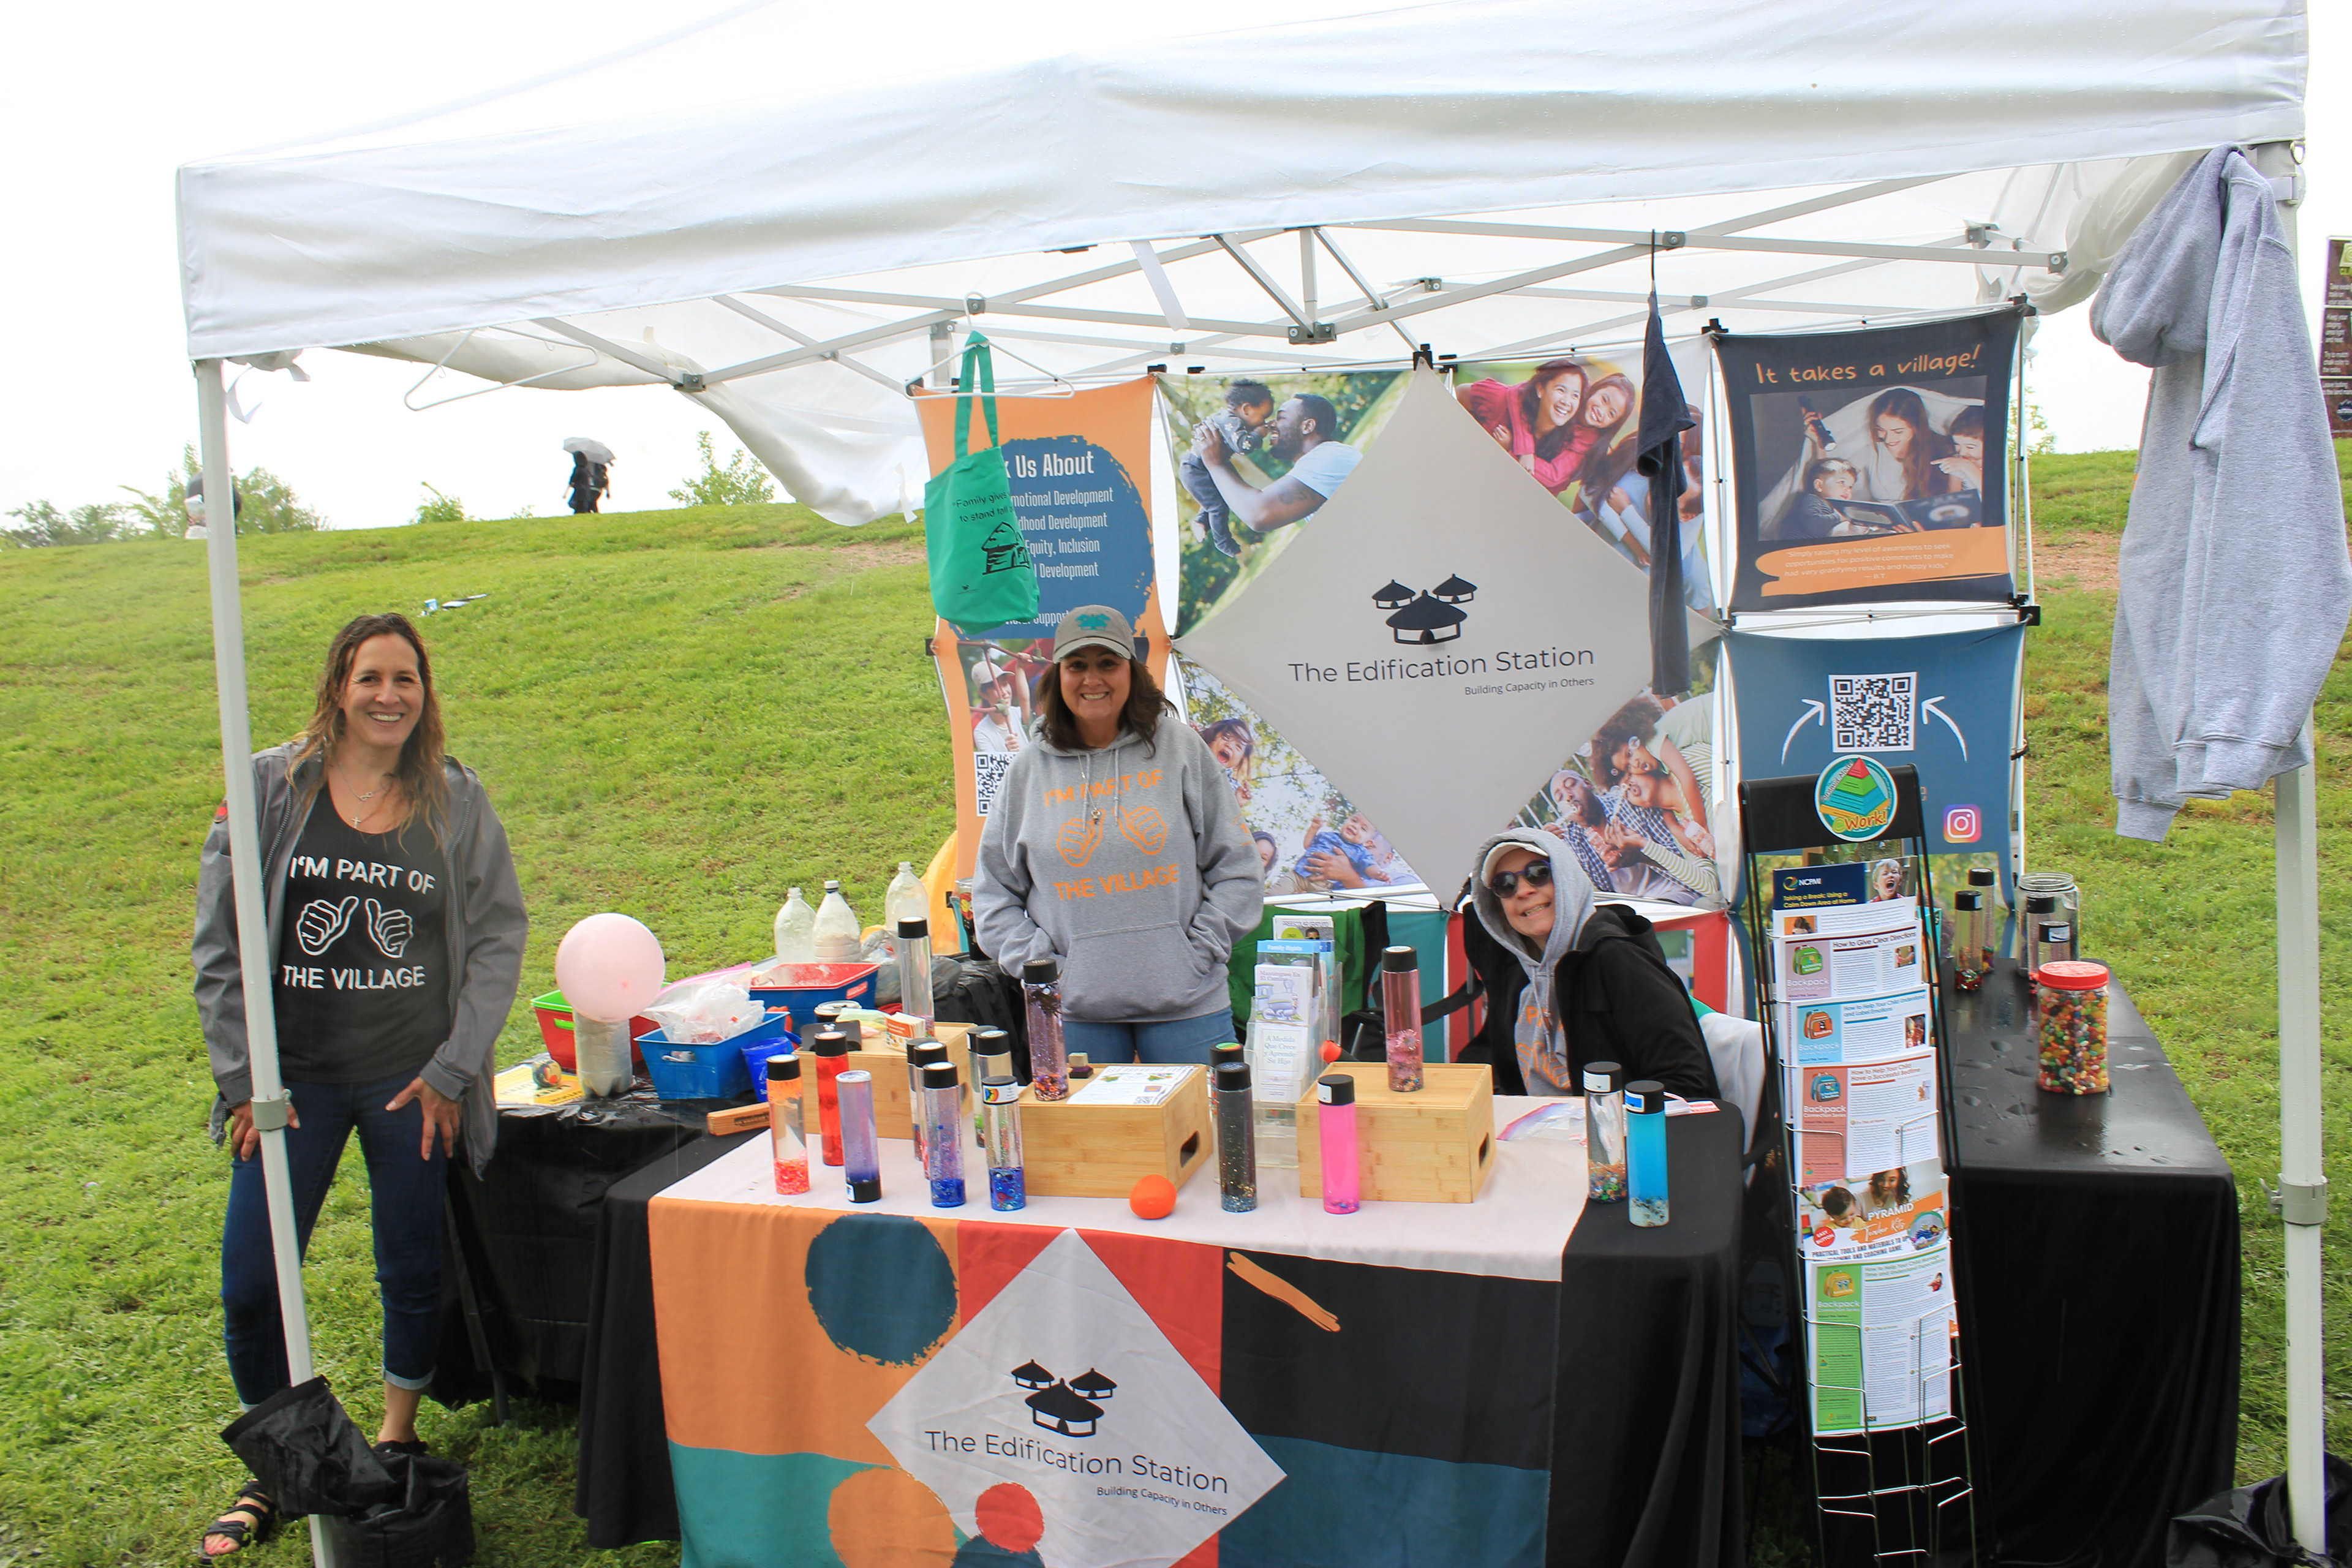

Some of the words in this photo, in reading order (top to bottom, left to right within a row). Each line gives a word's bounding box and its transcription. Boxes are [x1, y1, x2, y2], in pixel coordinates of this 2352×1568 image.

[1755, 363, 1778, 384] It
[1789, 364, 1857, 382] takes
[1869, 364, 1885, 377] a
[1898, 344, 1982, 375] village!
[1015, 454, 1037, 478] Us
[1042, 451, 1094, 477] About
[989, 492, 1007, 503] gives
[1054, 487, 1114, 507] Development
[971, 508, 995, 522] stand
[997, 506, 1009, 515] tall
[1049, 512, 1107, 532] Development
[1025, 538, 1057, 558] Equity,
[1058, 537, 1100, 554] Inclusion
[1814, 548, 1839, 557] raising
[1039, 562, 1099, 581] Development
[1785, 558, 1836, 568] opportunities
[1850, 555, 1880, 564] positive
[1819, 565, 1857, 575] gratifying
[1902, 562, 1927, 571] happy
[1288, 663, 1338, 682] The
[1347, 654, 1487, 681] Edification
[1496, 646, 1594, 672] Station
[1464, 684, 1503, 696] Building
[1506, 680, 1547, 693] Capacity
[1548, 679, 1558, 688] in
[1560, 676, 1594, 688] Others
[1044, 786, 1074, 807] I'M
[1080, 775, 1133, 799] PART
[1137, 769, 1164, 789] OF
[1819, 777, 1840, 802] Pyramid
[1839, 760, 1854, 778] Model
[290, 856, 330, 879] I'M
[336, 858, 404, 888] PART
[407, 870, 436, 895] OF
[1052, 878, 1096, 901] THE
[1098, 864, 1179, 895] VILLAGE
[1890, 932, 1917, 941] Directions
[282, 964, 325, 989] THE
[331, 965, 426, 990] VILLAGE
[1787, 978, 1830, 987] Backpack
[1803, 1105, 1847, 1114] Backpack
[1868, 1202, 1915, 1221] PYRAMID
[1815, 1233, 1836, 1244] BUTTON
[1816, 1229, 1829, 1238] EASY
[1811, 1249, 1839, 1258] PRACTICAL
[1840, 1246, 1856, 1255] TOOLS
[1868, 1238, 1895, 1251] MATERIALS
[1864, 1249, 1888, 1259] COACHING
[1888, 1244, 1902, 1254] GAME
[1817, 1300, 1861, 1309] Backpack
[924, 1430, 976, 1452] The
[986, 1434, 1123, 1475] Edification
[1132, 1455, 1229, 1494] Station
[1097, 1487, 1138, 1499] Building
[1140, 1488, 1180, 1508] Capacity
[1182, 1498, 1191, 1509] in
[1193, 1501, 1227, 1516] Others
